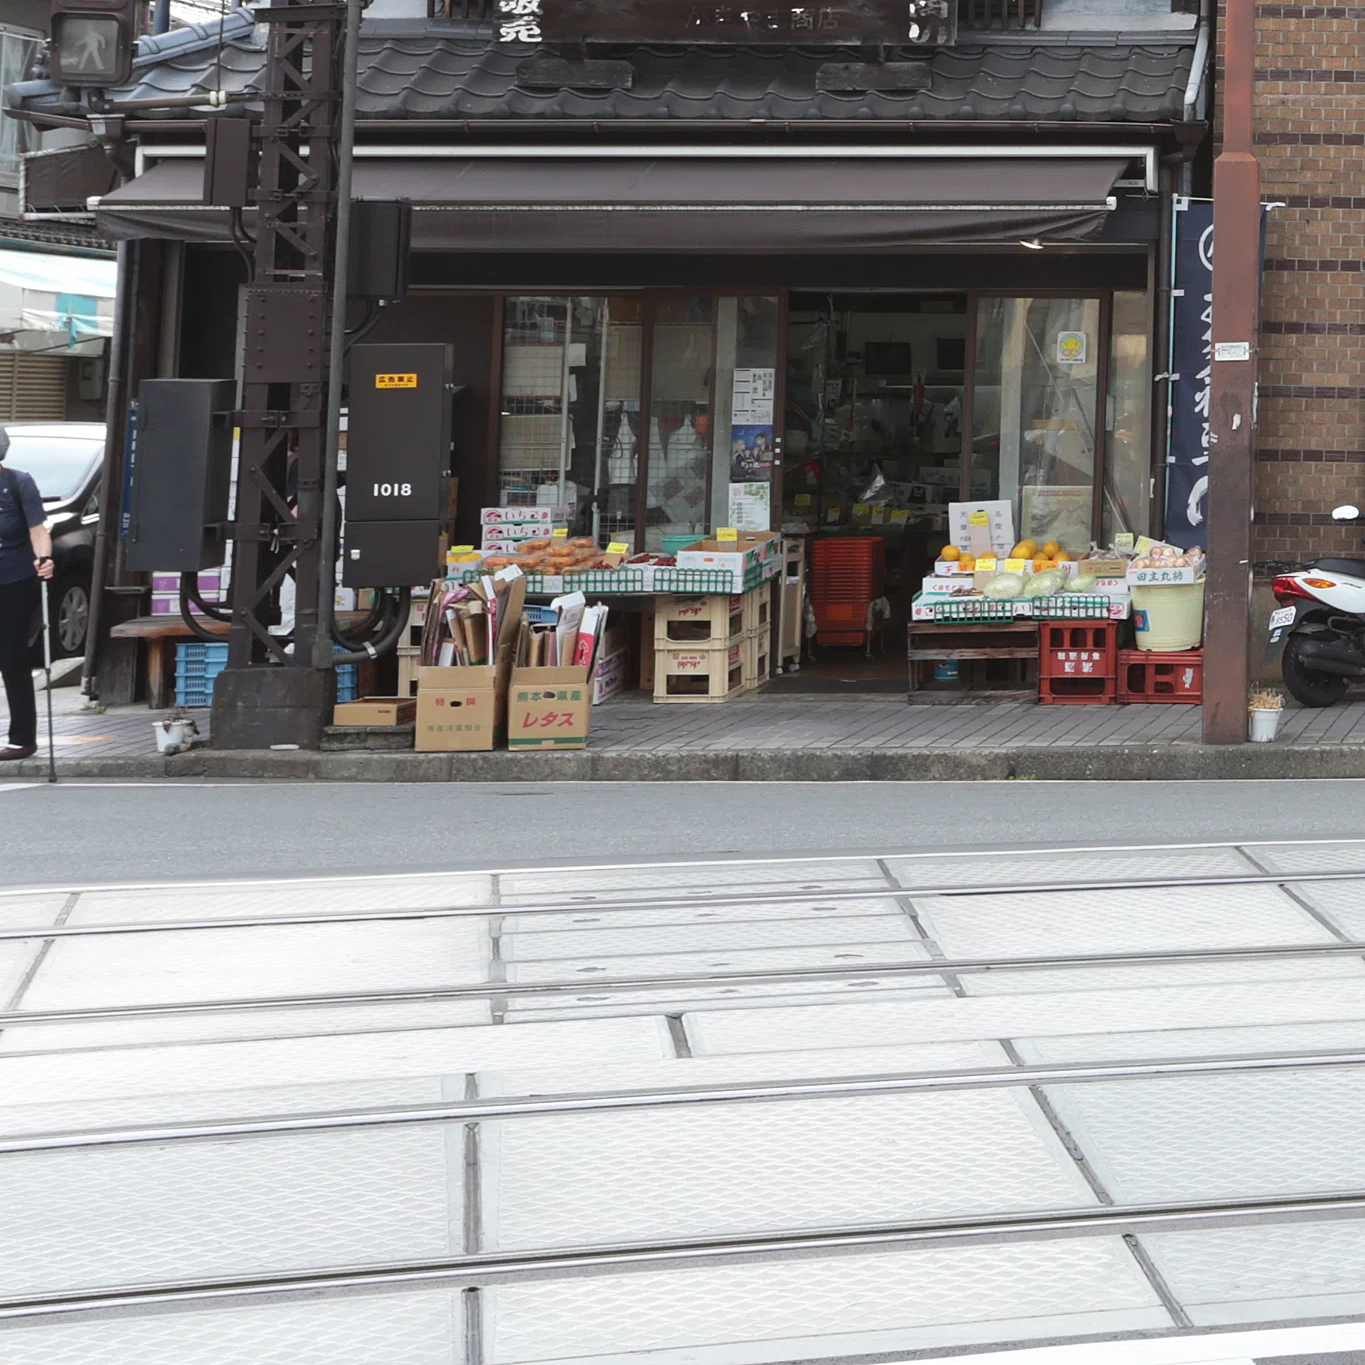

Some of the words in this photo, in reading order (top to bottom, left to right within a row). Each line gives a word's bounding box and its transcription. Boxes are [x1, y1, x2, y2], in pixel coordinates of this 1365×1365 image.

[373, 483, 412, 497] 1018
[516, 690, 584, 703] 熊本県産
[522, 712, 576, 729] レタス
